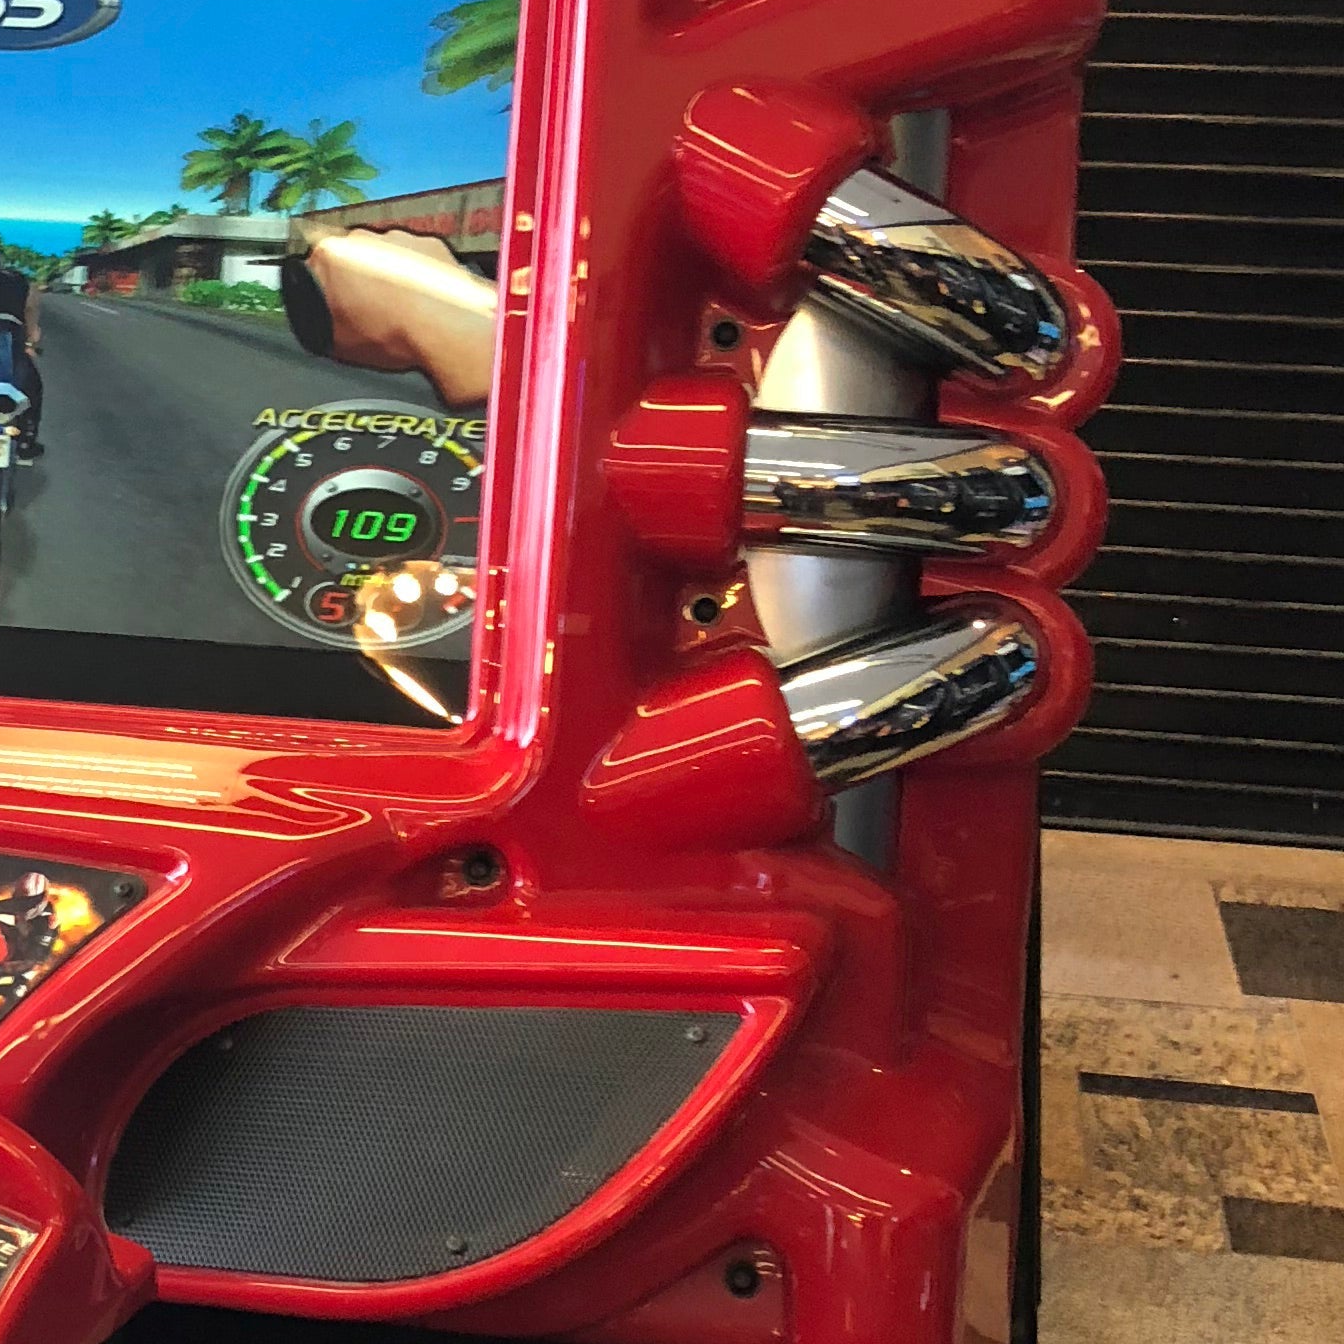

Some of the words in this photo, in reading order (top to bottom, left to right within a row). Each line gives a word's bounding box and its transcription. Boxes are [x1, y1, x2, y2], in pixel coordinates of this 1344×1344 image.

[252, 407, 488, 440] ACCELERATE
[333, 436, 353, 451] 6
[377, 435, 397, 449] 7
[295, 453, 314, 468] 5
[418, 451, 439, 465] 8
[268, 479, 288, 493] 4
[451, 477, 472, 492] 9
[260, 512, 279, 527] 3
[331, 509, 417, 542] 109
[266, 543, 288, 558] 2
[290, 575, 303, 589] 1
[318, 591, 349, 622] 5
